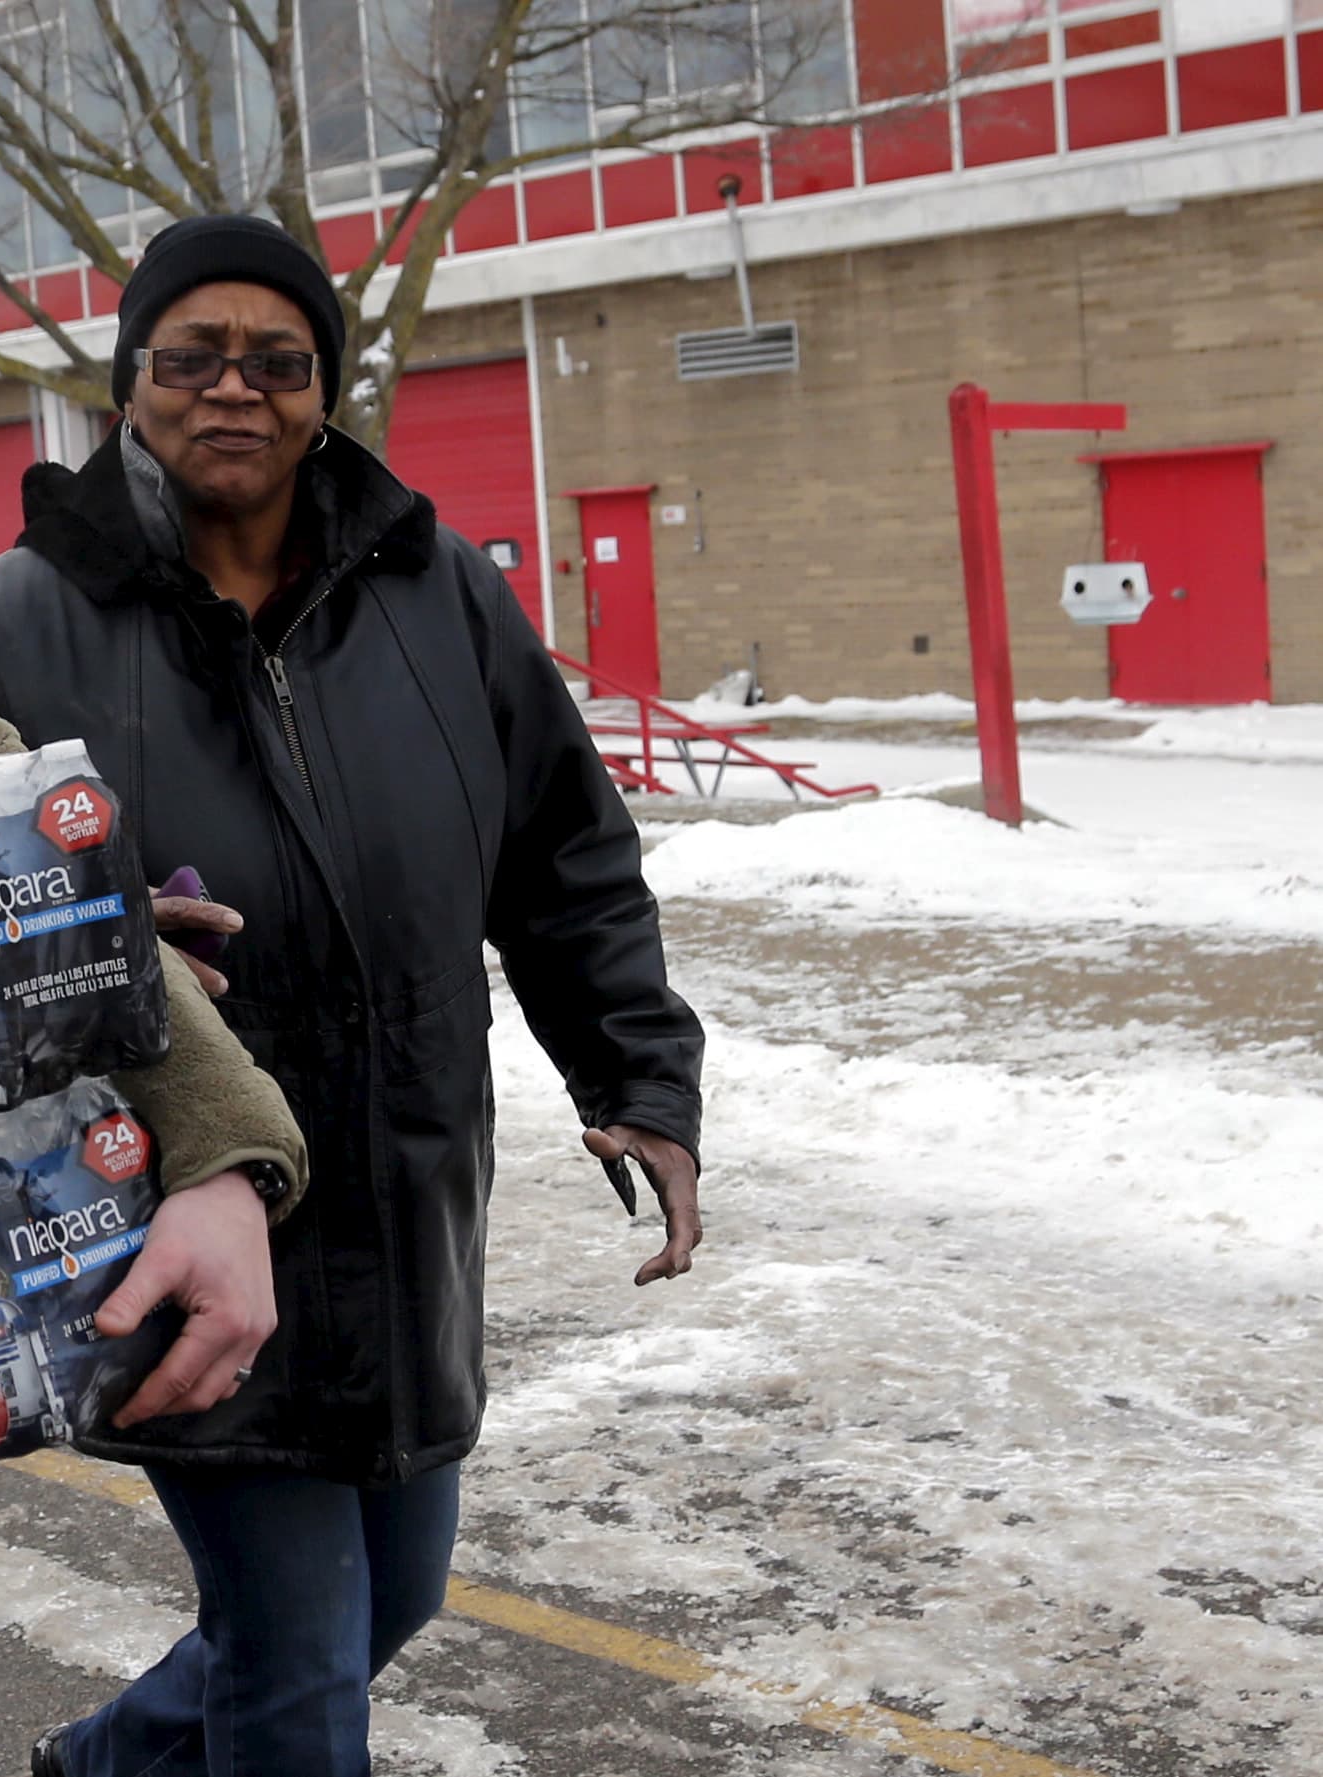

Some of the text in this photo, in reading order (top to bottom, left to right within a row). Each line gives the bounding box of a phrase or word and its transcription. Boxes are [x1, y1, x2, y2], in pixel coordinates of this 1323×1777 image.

[51, 790, 95, 825] 24
[59, 815, 101, 836] RECYCLABLE
[65, 824, 99, 842] BOTTLES
[22, 908, 75, 934] DRINKING
[75, 899, 118, 920] WATER
[83, 963, 94, 978] PT
[94, 957, 128, 976] BOTTLES
[56, 985, 66, 999] FL
[65, 983, 76, 997] OZ
[87, 978, 97, 993] L)
[113, 972, 131, 987] GAL
[94, 1122, 136, 1157] 24
[110, 1156, 141, 1173] BOTTLES
[8, 1196, 126, 1280] niagara
[21, 1264, 61, 1290] PURIFIED
[80, 1237, 128, 1268] DRINKING
